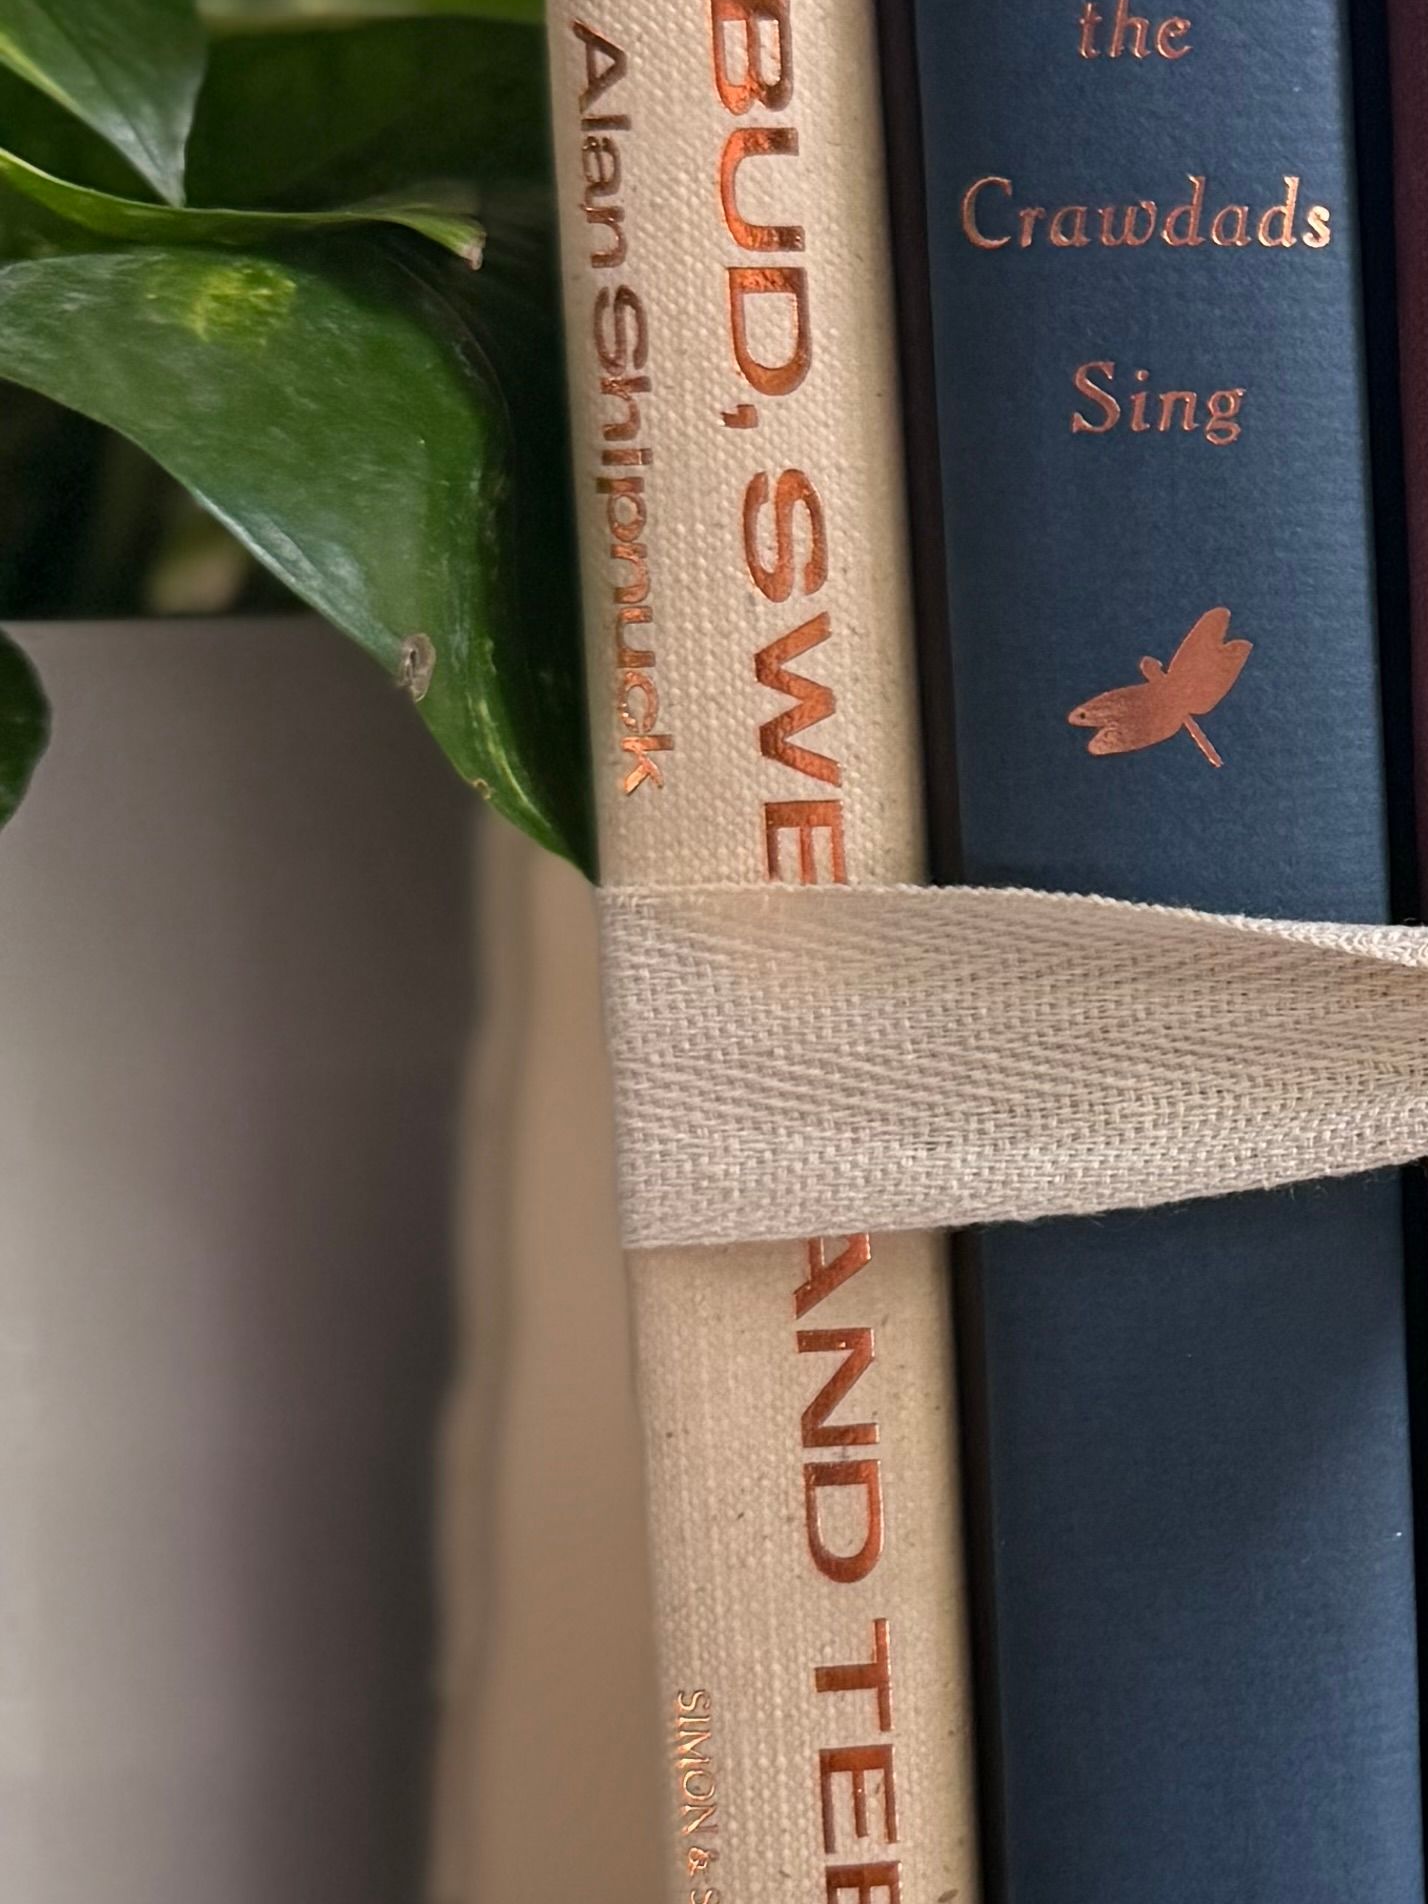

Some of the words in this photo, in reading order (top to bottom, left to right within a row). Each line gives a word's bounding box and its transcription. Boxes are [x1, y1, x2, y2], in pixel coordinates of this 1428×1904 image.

[571, 18, 633, 270] Alan
[962, 175, 1332, 249] Crawdads
[1071, 362, 1244, 446] Sing
[592, 284, 675, 797] Shipnuck
[675, 1689, 722, 1837] SIMON
[688, 1847, 720, 1876] &
